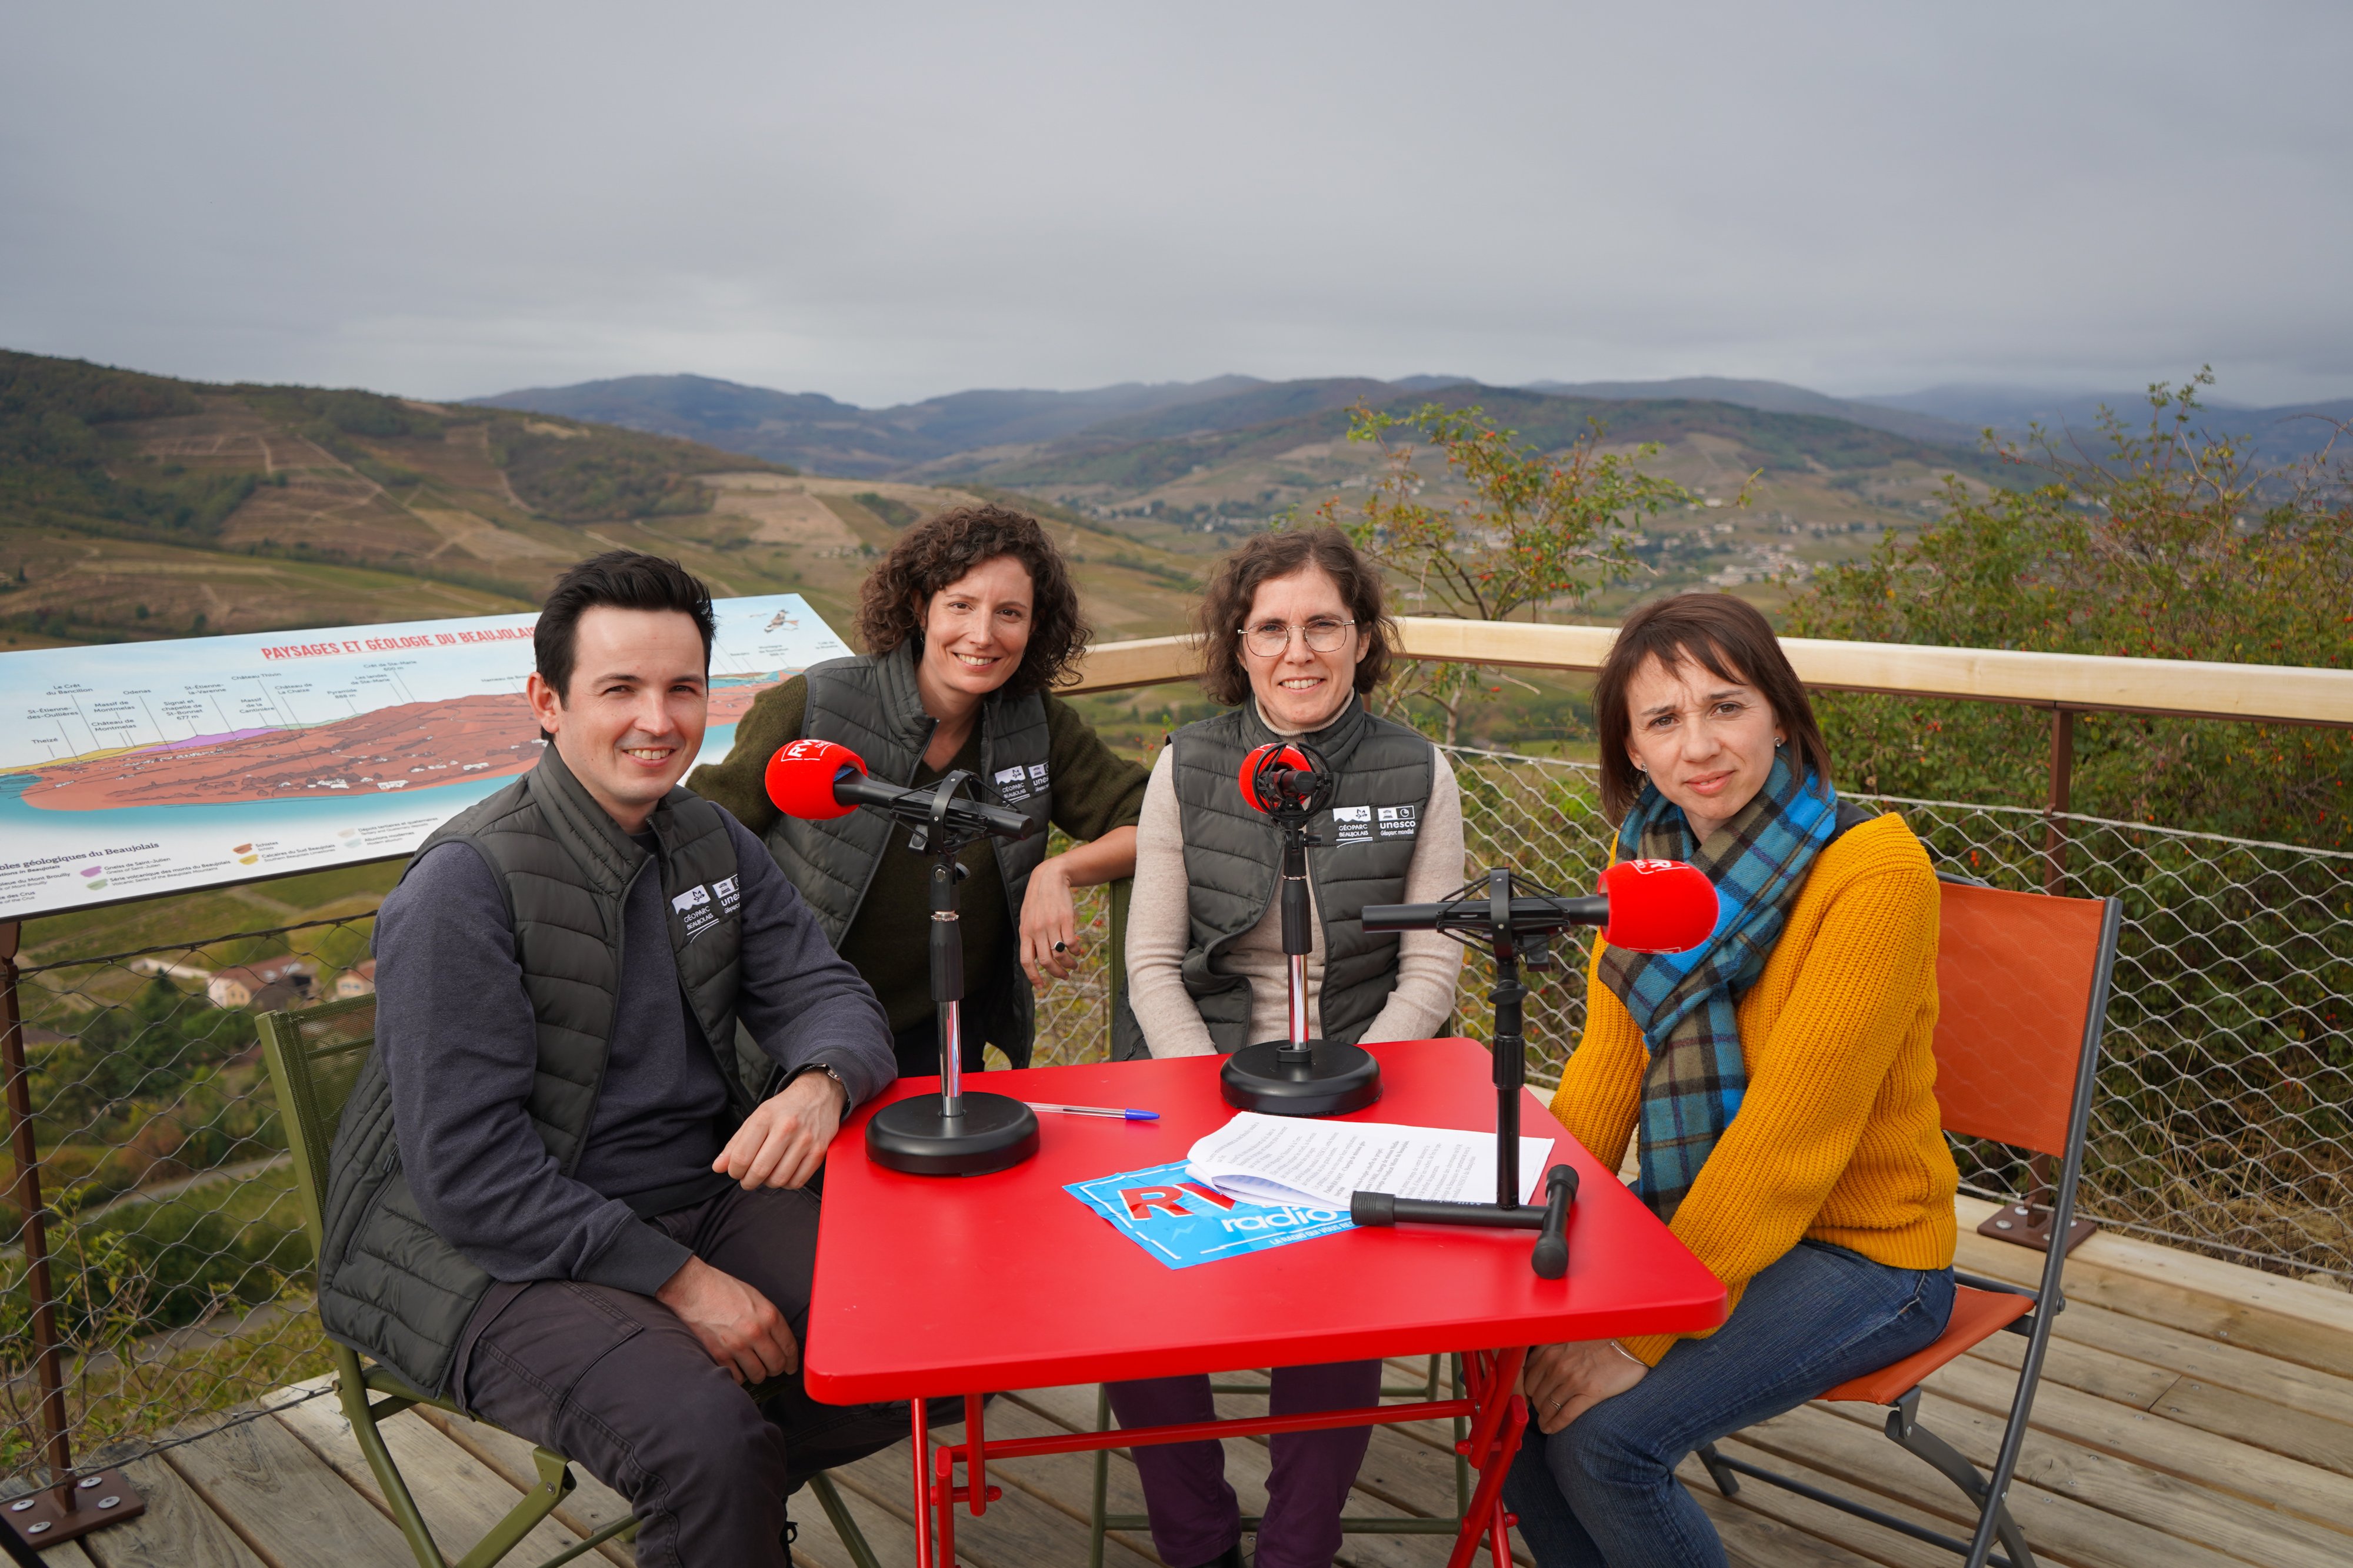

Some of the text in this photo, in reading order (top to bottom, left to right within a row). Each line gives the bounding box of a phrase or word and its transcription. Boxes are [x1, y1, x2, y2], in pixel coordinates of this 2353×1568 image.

[261, 643, 339, 659] PAYSAGES
[342, 640, 362, 653] ET
[365, 636, 434, 650] GÉOLOGIE
[434, 633, 456, 645] DU
[27, 711, 79, 720] des-Oullières
[95, 723, 137, 732] Montmelas
[1033, 776, 1049, 786] unes
[1002, 782, 1025, 793] GÉOPARC
[1380, 821, 1416, 829] unesco
[308, 843, 336, 852] Beaujolais
[24, 856, 86, 868] géologiques
[104, 842, 159, 855] Beaujolais
[135, 856, 171, 866] Saint-Julien
[27, 865, 61, 873] Beaujolais
[127, 871, 159, 879] volcanique
[201, 860, 231, 868] Beaujolais
[721, 892, 739, 906] unes
[684, 906, 711, 923] GÉOPARC
[686, 913, 714, 930] BEAUJOLAIS
[1221, 1207, 1338, 1232] radio
[1281, 1233, 1307, 1242] RADIO
[1305, 1229, 1321, 1237] QUI
[1318, 1224, 1342, 1233] VOUS
